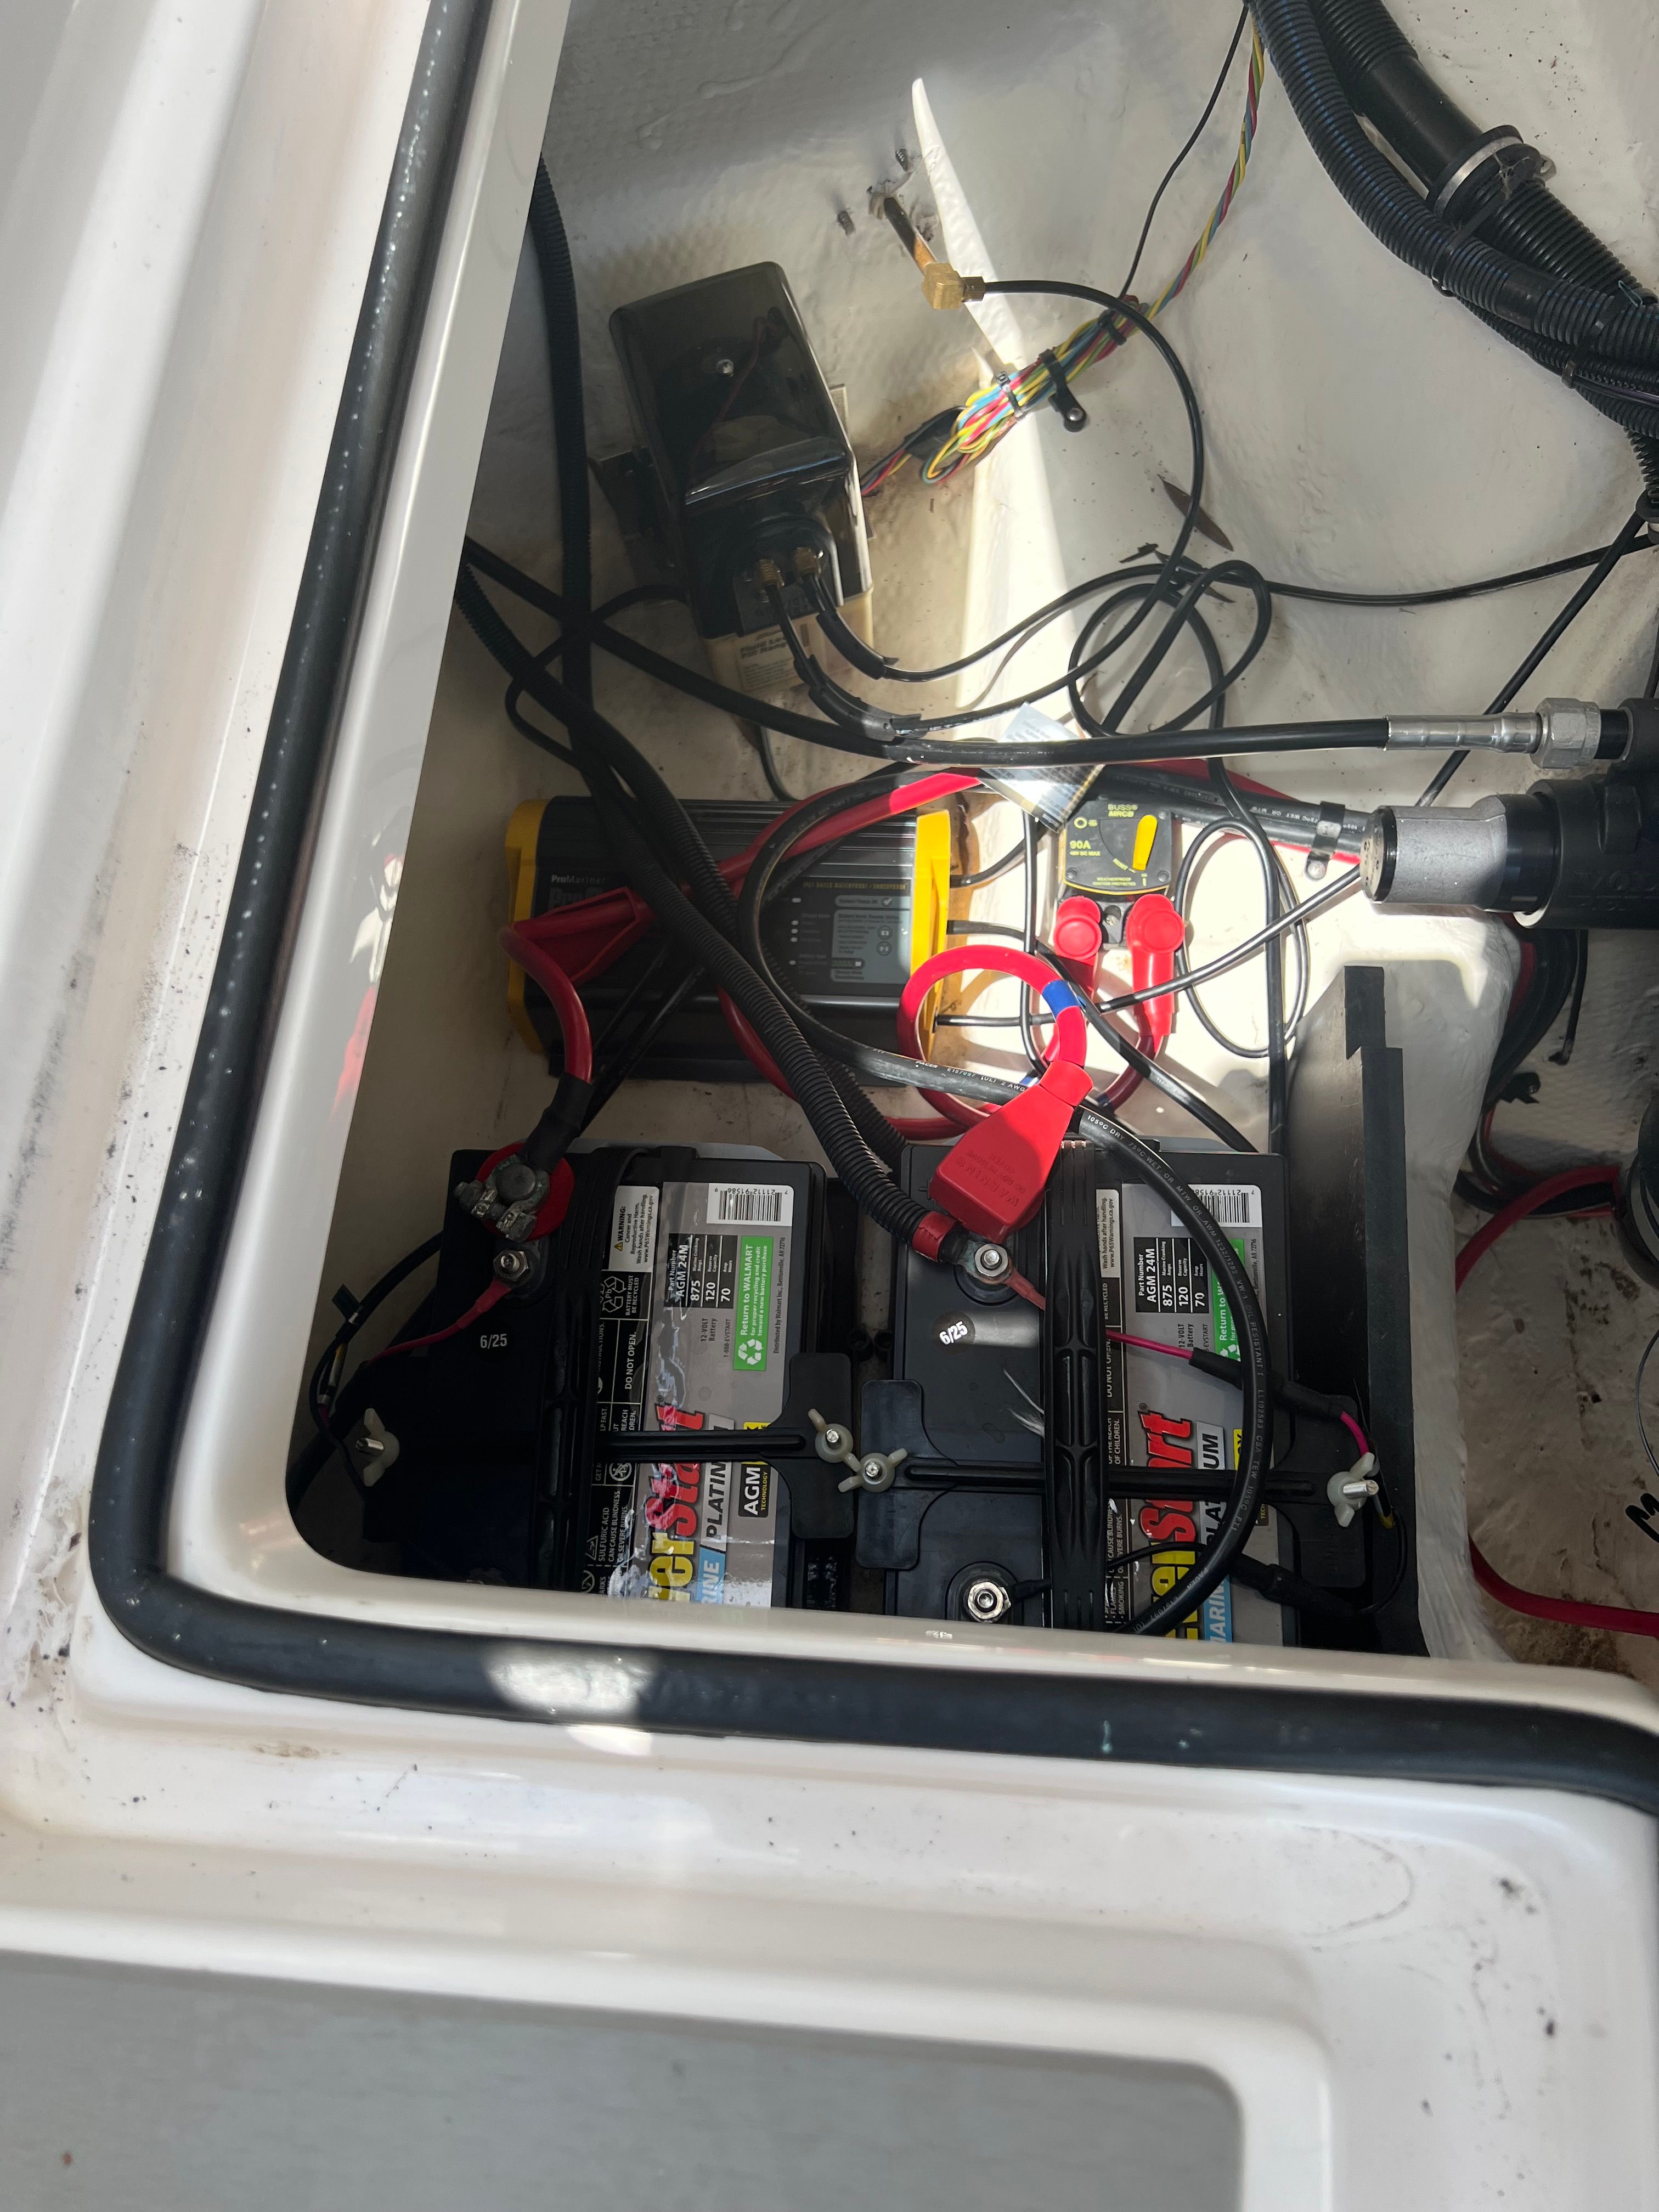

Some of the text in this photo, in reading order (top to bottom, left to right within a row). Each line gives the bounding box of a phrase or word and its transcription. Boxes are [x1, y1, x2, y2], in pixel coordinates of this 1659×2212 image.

[1070, 840, 1091, 849] 90A
[617, 1206, 625, 1242] WARNING:
[630, 1219, 639, 1255] Reproductive
[1109, 1128, 1125, 1141] DRY
[1147, 1156, 1163, 1170] WET
[1164, 1173, 1174, 1183] OR
[1176, 1186, 1192, 1201] MTW
[1193, 1205, 1203, 1216] OR
[1203, 1219, 1217, 1237] AWM
[1250, 1322, 1263, 1368] RESISTANT
[668, 1249, 678, 1291] Part Number
[675, 1244, 689, 1297] AGM 24M
[1145, 1248, 1157, 1303] AGM 24M
[605, 1289, 612, 1299] Pb
[690, 1279, 701, 1301] 875
[705, 1282, 716, 1301] 120
[720, 1288, 731, 1302] 70
[740, 1244, 754, 1336] Return to WALMART
[753, 1277, 761, 1305] recycling
[759, 1273, 768, 1295] battery
[1162, 1284, 1173, 1307] 875
[1178, 1286, 1189, 1307] 120
[1194, 1292, 1205, 1307] 70
[1218, 1297, 1226, 1307] to
[709, 1318, 718, 1342] Battery
[939, 1321, 968, 1345] 6/25
[1187, 1323, 1195, 1347] Battery
[1219, 1309, 1227, 1341] Return
[480, 1334, 507, 1348] 6/25
[624, 1376, 632, 1390] DO
[628, 1331, 636, 1357] OPEN.
[620, 1409, 629, 1431] REACH
[1115, 1454, 1121, 1465] OF
[743, 1466, 761, 1516] AGM
[760, 1471, 769, 1511] TECHNOLOGY
[611, 1490, 621, 1526] BLINDNESS
[599, 1507, 610, 1562] SULFURIC ACID
[618, 1529, 626, 1553] SEVERE
[616, 1553, 624, 1562] OR
